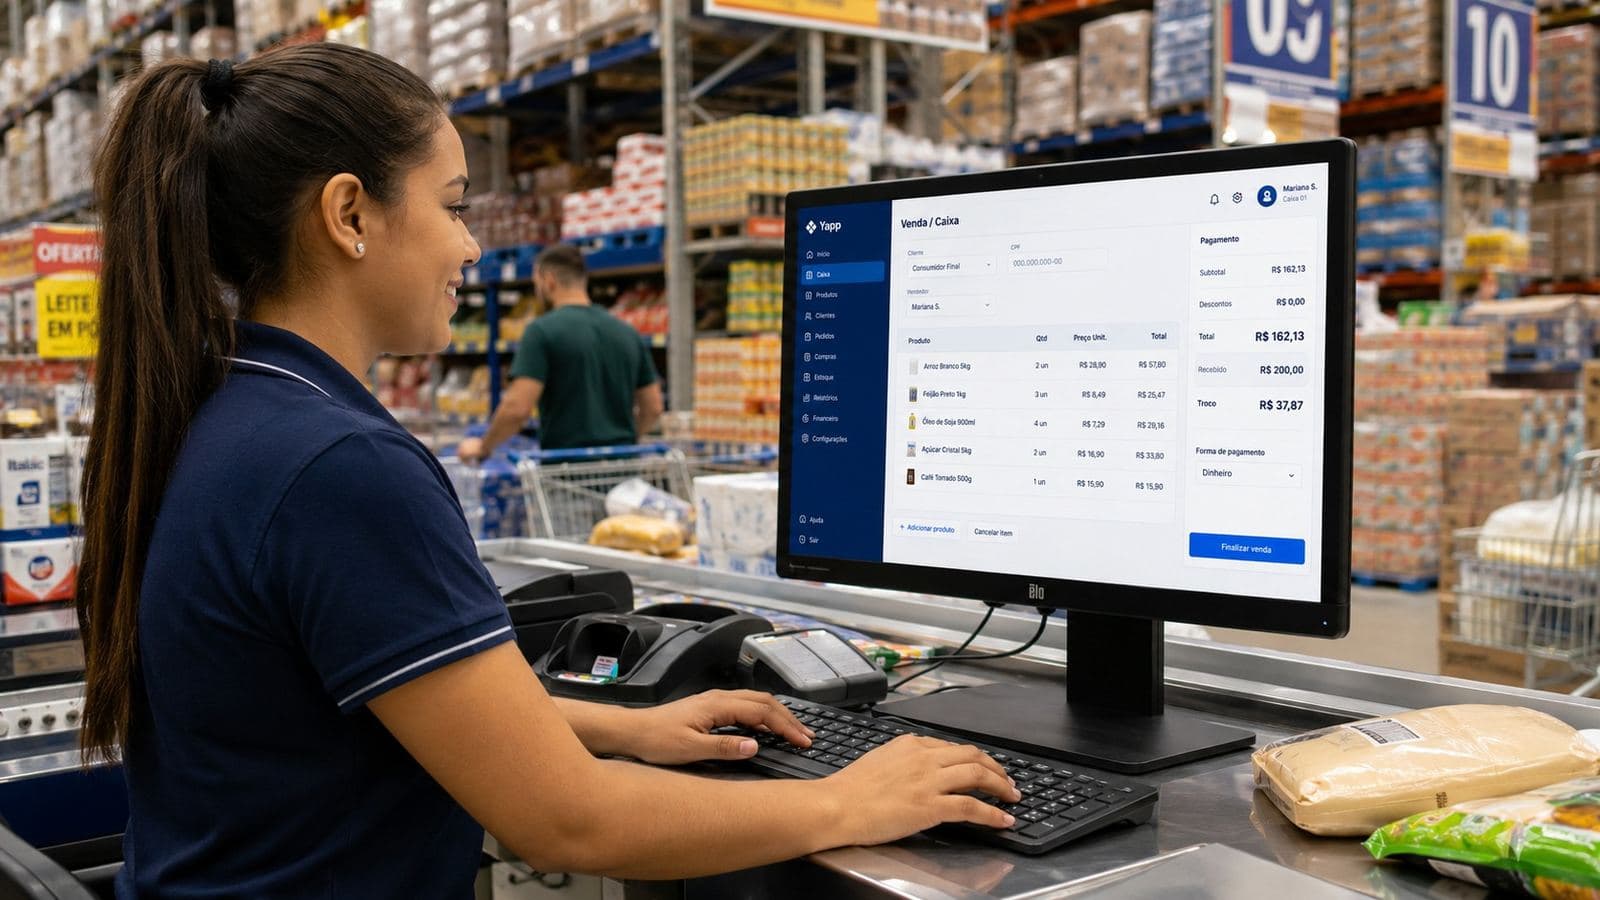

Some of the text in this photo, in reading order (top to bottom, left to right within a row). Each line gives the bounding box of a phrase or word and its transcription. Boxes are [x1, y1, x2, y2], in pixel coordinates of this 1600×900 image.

[1466, 6, 1519, 108] 10
[1283, 184, 1309, 192] Mariana
[820, 221, 842, 232] Yapp
[901, 216, 959, 228] Venda / Caixa
[1200, 236, 1239, 245] Pagamento
[1013, 258, 1062, 267] 000.000.000-00
[1272, 266, 1281, 274] R$
[1284, 265, 1306, 274] 162,13
[46, 294, 90, 314] LEITE
[1288, 298, 1305, 306] 0,00
[48, 320, 72, 338] EM
[1256, 331, 1269, 342] R$
[1272, 331, 1304, 342] 162,13
[960, 363, 971, 371] 5kg
[1260, 366, 1271, 375] R$
[1274, 366, 1304, 375] 200,00
[957, 391, 966, 399] 1kg
[1260, 400, 1273, 411] R$
[1276, 400, 1304, 412] 37,87
[922, 417, 935, 425] Óleo
[944, 418, 956, 427] Soja
[812, 435, 847, 444] Configurações
[922, 446, 941, 454] Açúcar
[961, 447, 972, 455] 5kg
[1202, 469, 1232, 477] Dinheiro
[957, 475, 972, 483] 500g
[907, 524, 932, 532] Adicionar
[933, 525, 955, 534] produto
[974, 528, 999, 536] Cancelar
[1221, 543, 1249, 552] Finalizar
